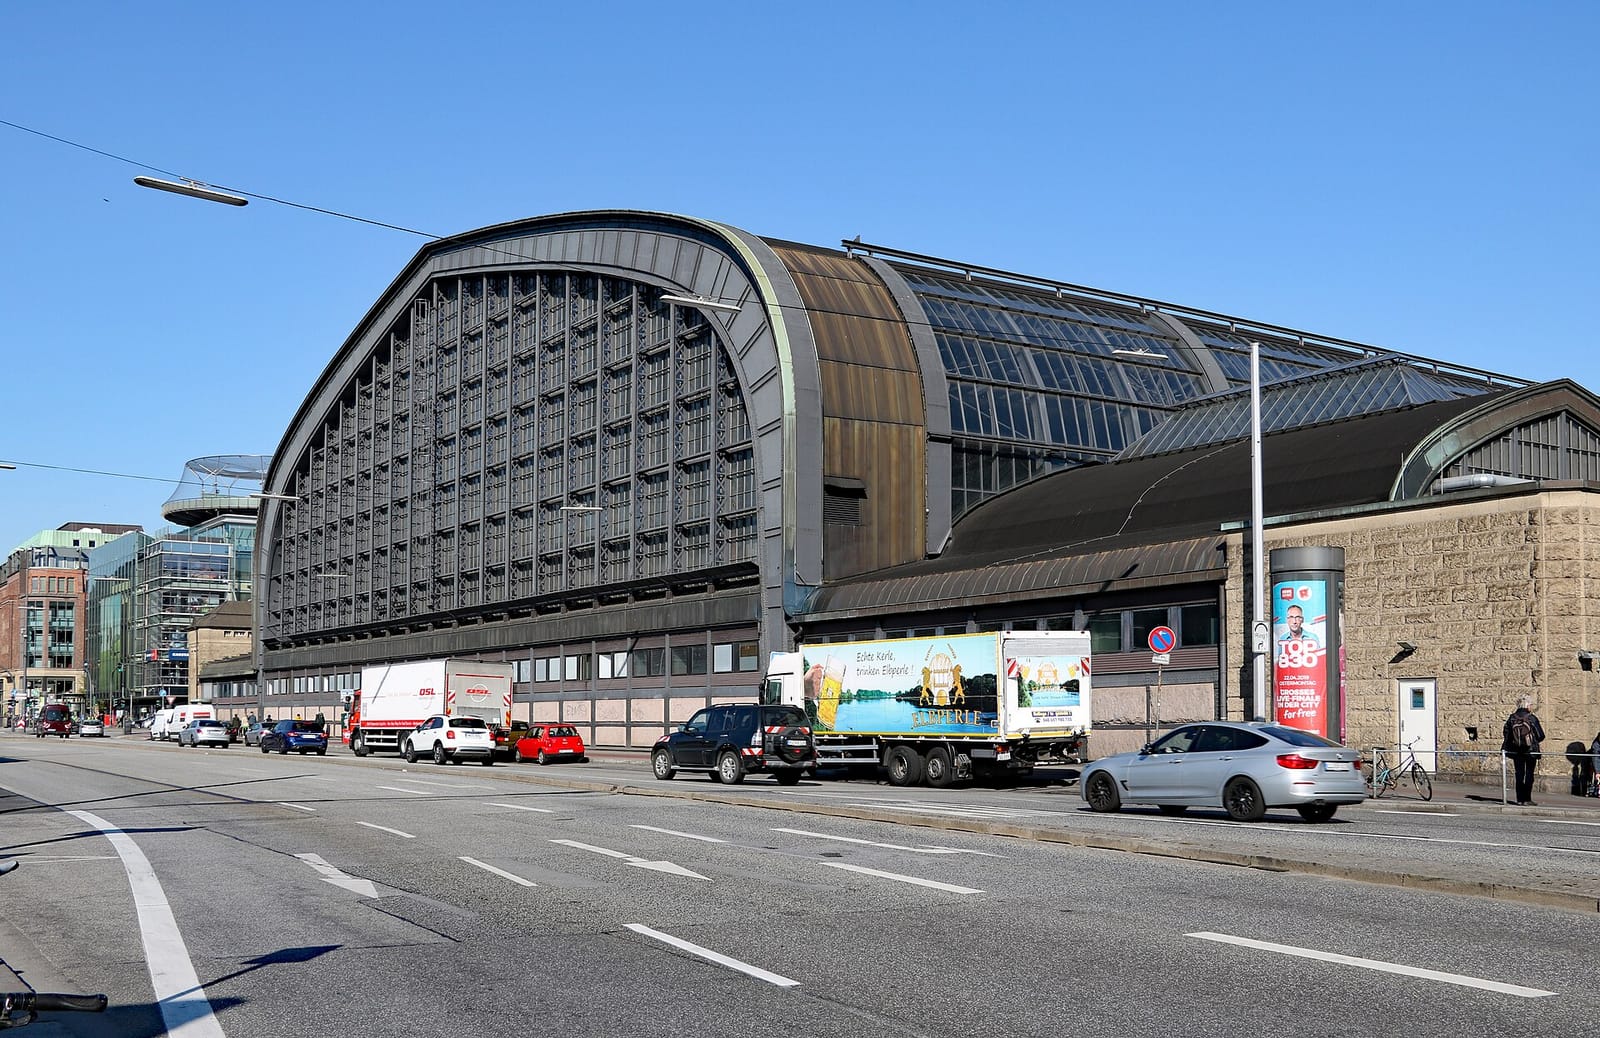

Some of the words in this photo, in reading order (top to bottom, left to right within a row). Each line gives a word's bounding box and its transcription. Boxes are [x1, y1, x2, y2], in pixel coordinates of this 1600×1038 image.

[1278, 640, 1318, 656] TOP
[856, 651, 875, 662] Echte
[876, 650, 896, 661] Kerle,
[1278, 653, 1318, 668] 830
[856, 665, 880, 676] trinken
[882, 664, 909, 678] Elbperle
[1280, 688, 1315, 696] GROSSES
[911, 709, 982, 730] ELBPERLE
[1283, 709, 1297, 719] for
[1297, 708, 1317, 718] free
